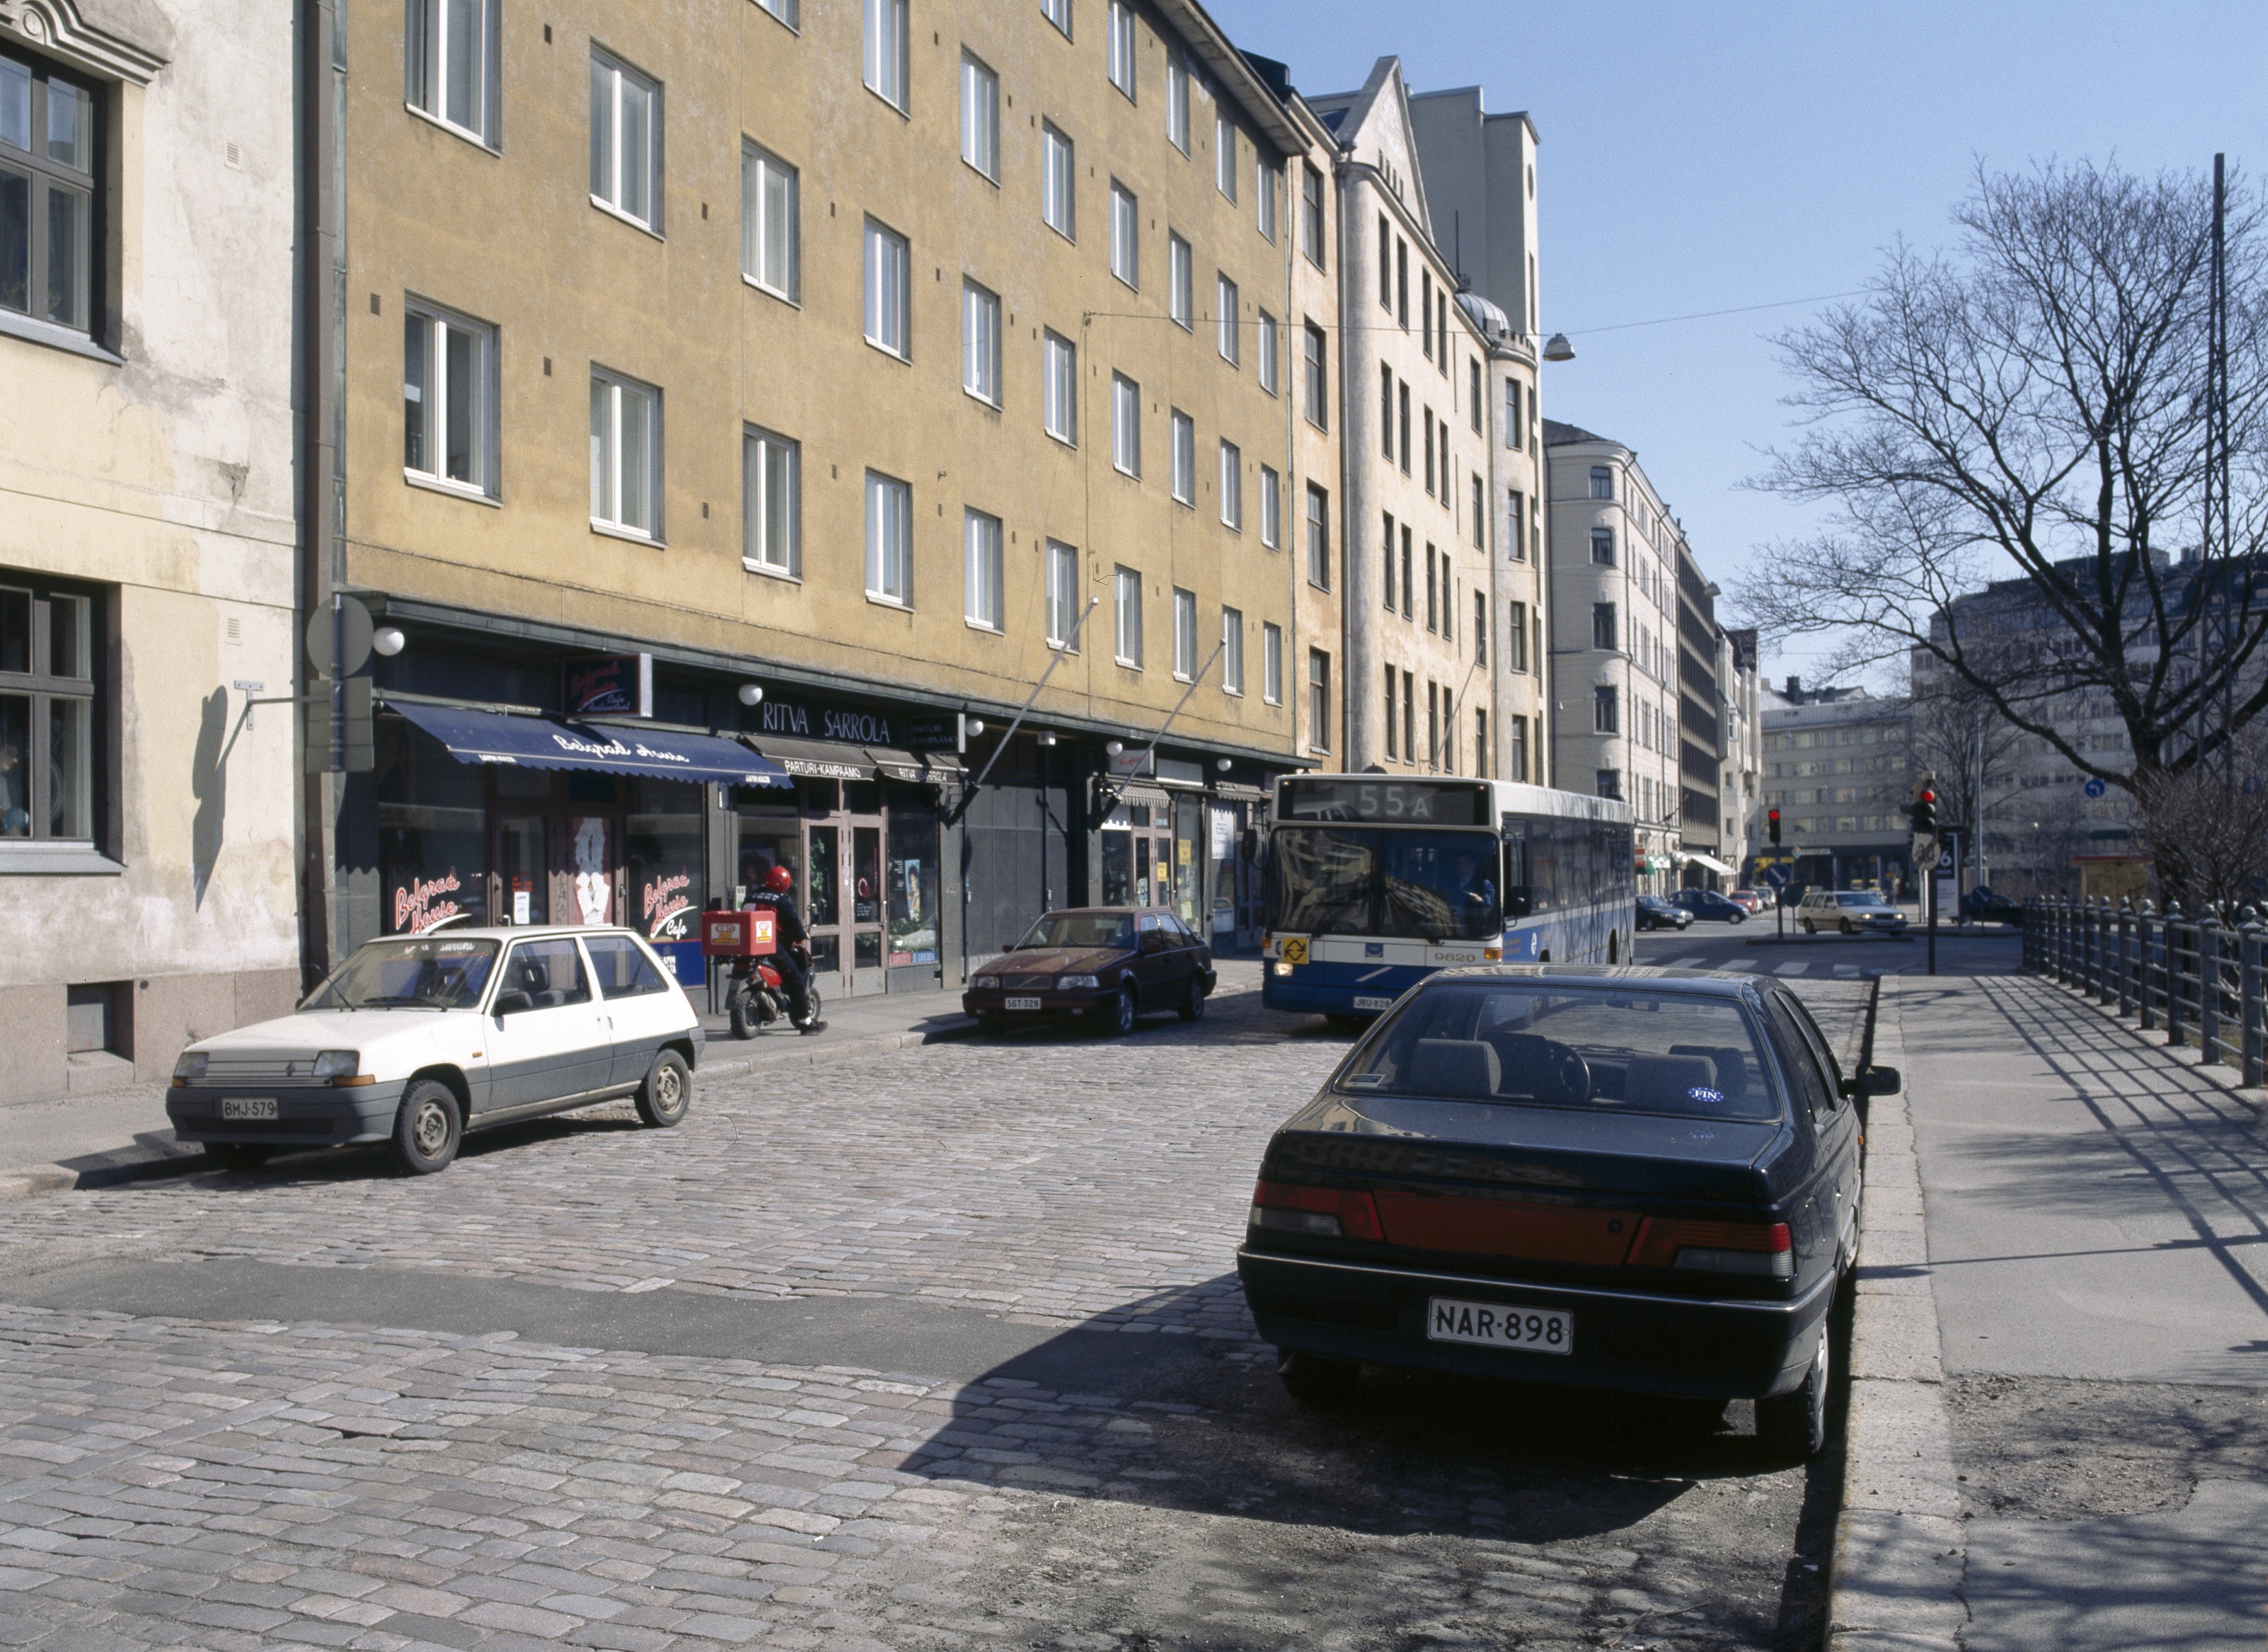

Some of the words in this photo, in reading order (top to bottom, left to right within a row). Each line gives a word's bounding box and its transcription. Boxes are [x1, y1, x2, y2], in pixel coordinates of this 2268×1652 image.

[571, 660, 621, 698] Belgrad
[578, 681, 618, 710] House
[607, 693, 625, 707] Cafe
[764, 702, 809, 734] RITVA
[825, 710, 890, 743] SARROLA
[553, 735, 631, 759] Belgrad
[636, 743, 690, 762] House
[784, 760, 861, 779] PARTURI-KAMPAAMO
[899, 768, 916, 780] RITVA
[920, 770, 947, 782] SARROLA
[1939, 850, 1952, 866] 6
[396, 866, 460, 931] Belgrad
[645, 866, 690, 919] Belgrad
[410, 900, 458, 934] House
[651, 895, 689, 934] House
[666, 918, 688, 940] Cafe
[1435, 952, 1476, 963] 9620
[1007, 999, 1039, 1008] SGT-328
[1695, 1090, 1717, 1099] FIN
[225, 1102, 274, 1116] BMJ-579
[1437, 1305, 1562, 1345] NAR-898
